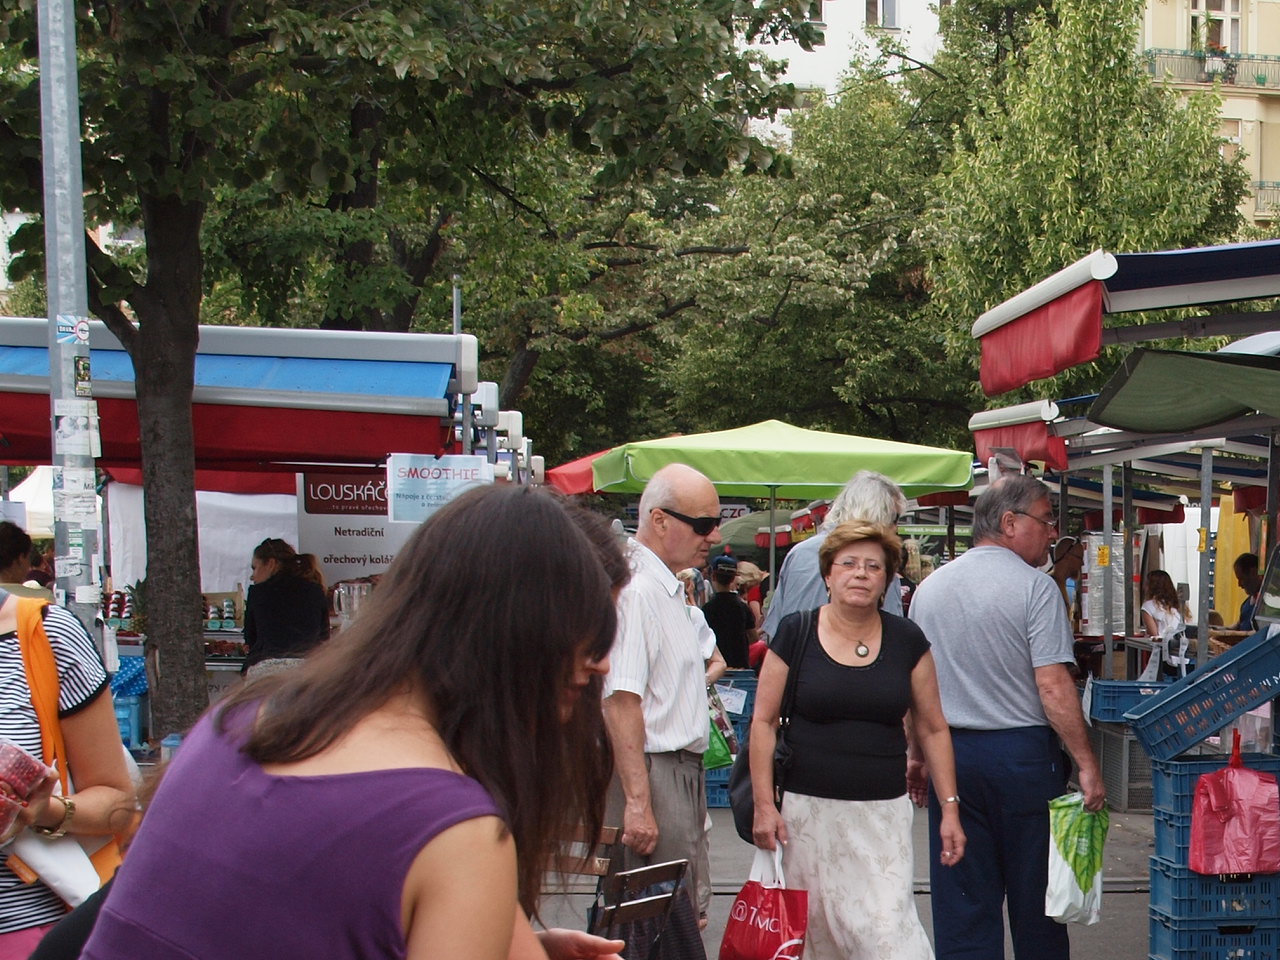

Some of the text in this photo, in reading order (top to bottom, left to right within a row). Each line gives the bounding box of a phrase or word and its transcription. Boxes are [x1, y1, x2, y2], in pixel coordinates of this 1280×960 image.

[397, 467, 480, 480] SMOOTHIE
[361, 504, 389, 513] ořechov
[334, 526, 384, 537] Netradiční
[323, 552, 368, 566] ořechový
